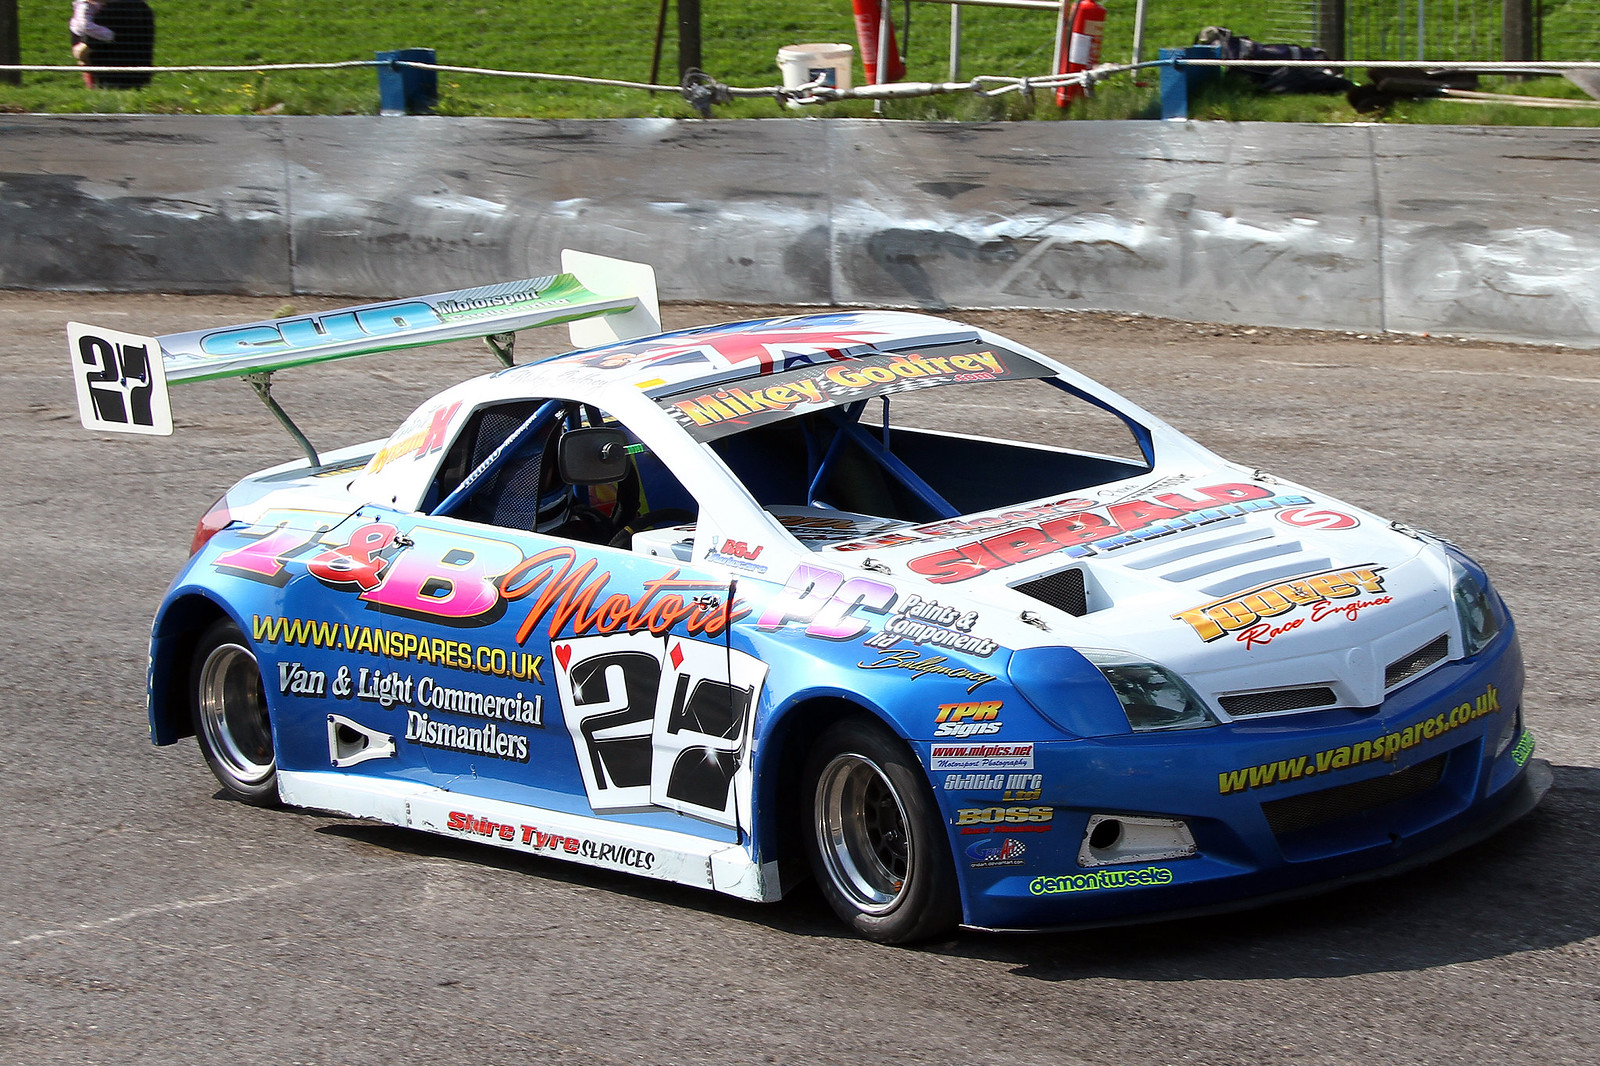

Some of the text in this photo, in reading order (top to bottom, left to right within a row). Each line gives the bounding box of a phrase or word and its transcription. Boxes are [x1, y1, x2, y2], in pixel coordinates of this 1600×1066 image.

[436, 287, 540, 314] Motorsport
[78, 334, 154, 427] 27
[674, 350, 1007, 428] Mikey Godfrey
[953, 371, 997, 383] .com
[906, 481, 1277, 585] SIBBALD
[499, 546, 755, 645] Motors
[757, 562, 898, 641] PC
[898, 594, 979, 633] Paints &
[252, 614, 544, 683] WWW.VANSPARES.CO.UK
[884, 614, 1000, 659] Components
[1237, 595, 1393, 651] Race Engines
[278, 661, 543, 727] Van & Light Commercial
[934, 700, 1004, 723] TPR
[405, 708, 529, 760] Dismantlers
[931, 745, 1033, 758] www.mkpics.net
[933, 721, 1003, 738] Signs
[1217, 683, 1500, 795] www.vanspares.co.uk
[937, 757, 1028, 769] Motorsport Photography
[447, 810, 656, 871] Shire Tyre SERVICES
[955, 806, 1054, 826] BOSS
[1029, 866, 1174, 896] demon tweeks
